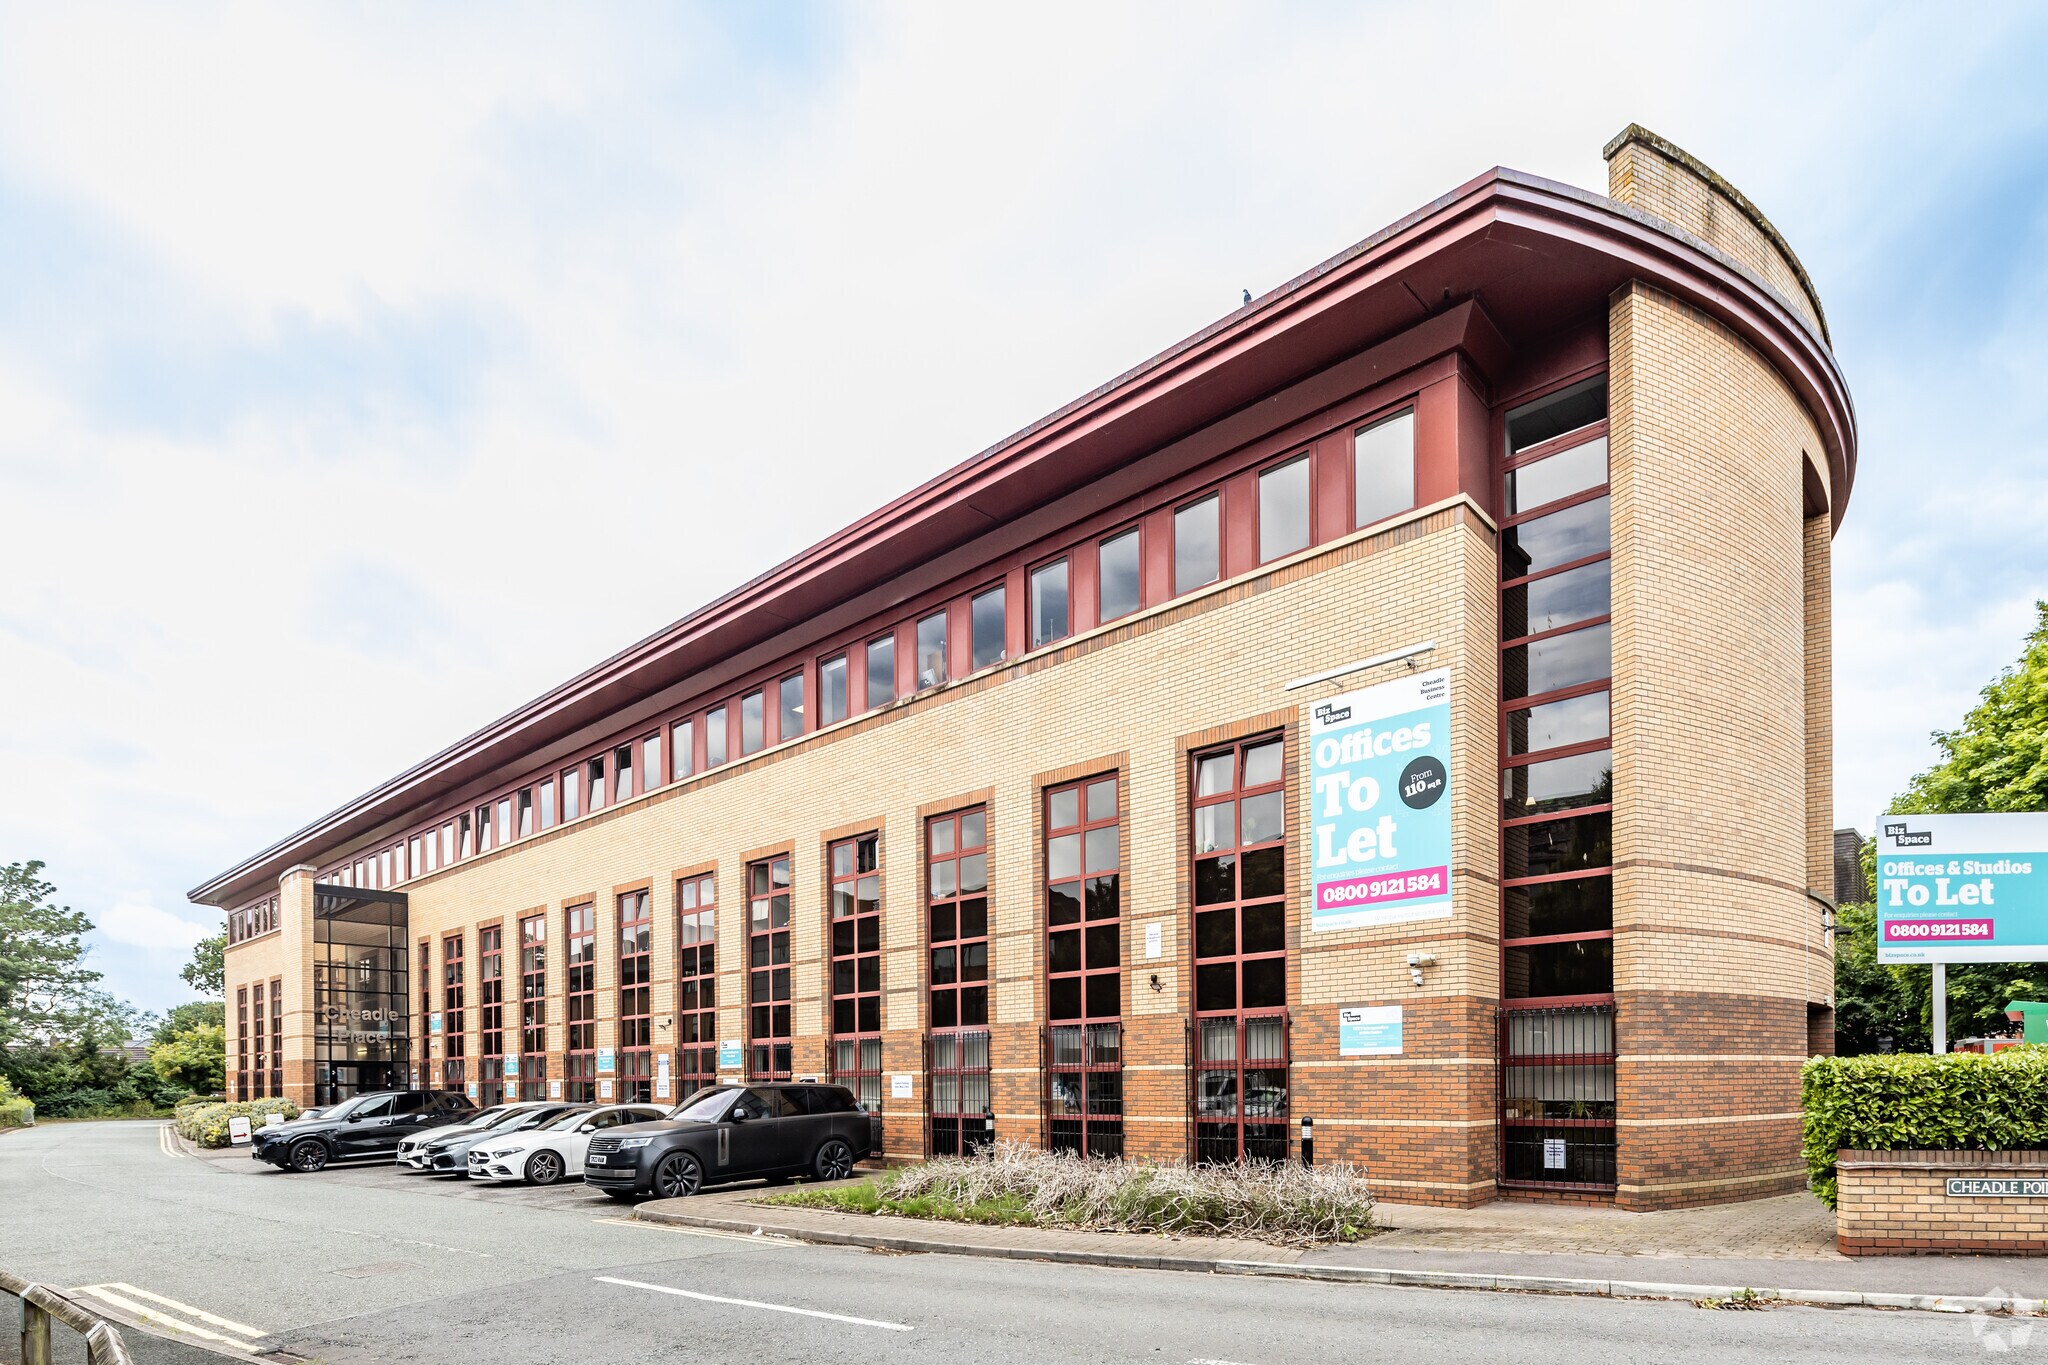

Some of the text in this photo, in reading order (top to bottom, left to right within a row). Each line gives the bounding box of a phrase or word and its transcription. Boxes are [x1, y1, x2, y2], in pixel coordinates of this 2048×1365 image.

[1422, 677, 1445, 687] Cheadle
[1420, 685, 1445, 695] Business
[1426, 692, 1445, 701] Centre
[1317, 707, 1331, 717] Biz
[1325, 710, 1350, 723] Space
[1315, 722, 1431, 769] Offices
[1410, 769, 1433, 783] From
[1315, 770, 1380, 818] To
[1404, 780, 1427, 798] 110
[1887, 826, 1905, 835] Biz
[1316, 815, 1398, 869] Let
[1898, 835, 1930, 845] Space
[1883, 860, 2033, 877] Offices & Studios
[1323, 873, 1441, 903] 0800 9121 584
[1883, 877, 1995, 907] To Let
[1890, 923, 1989, 937] 0800 9121 584
[325, 1005, 399, 1022] Cheadle
[337, 1029, 387, 1044] Place
[1951, 1180, 2048, 1194] CHEADLE POI
